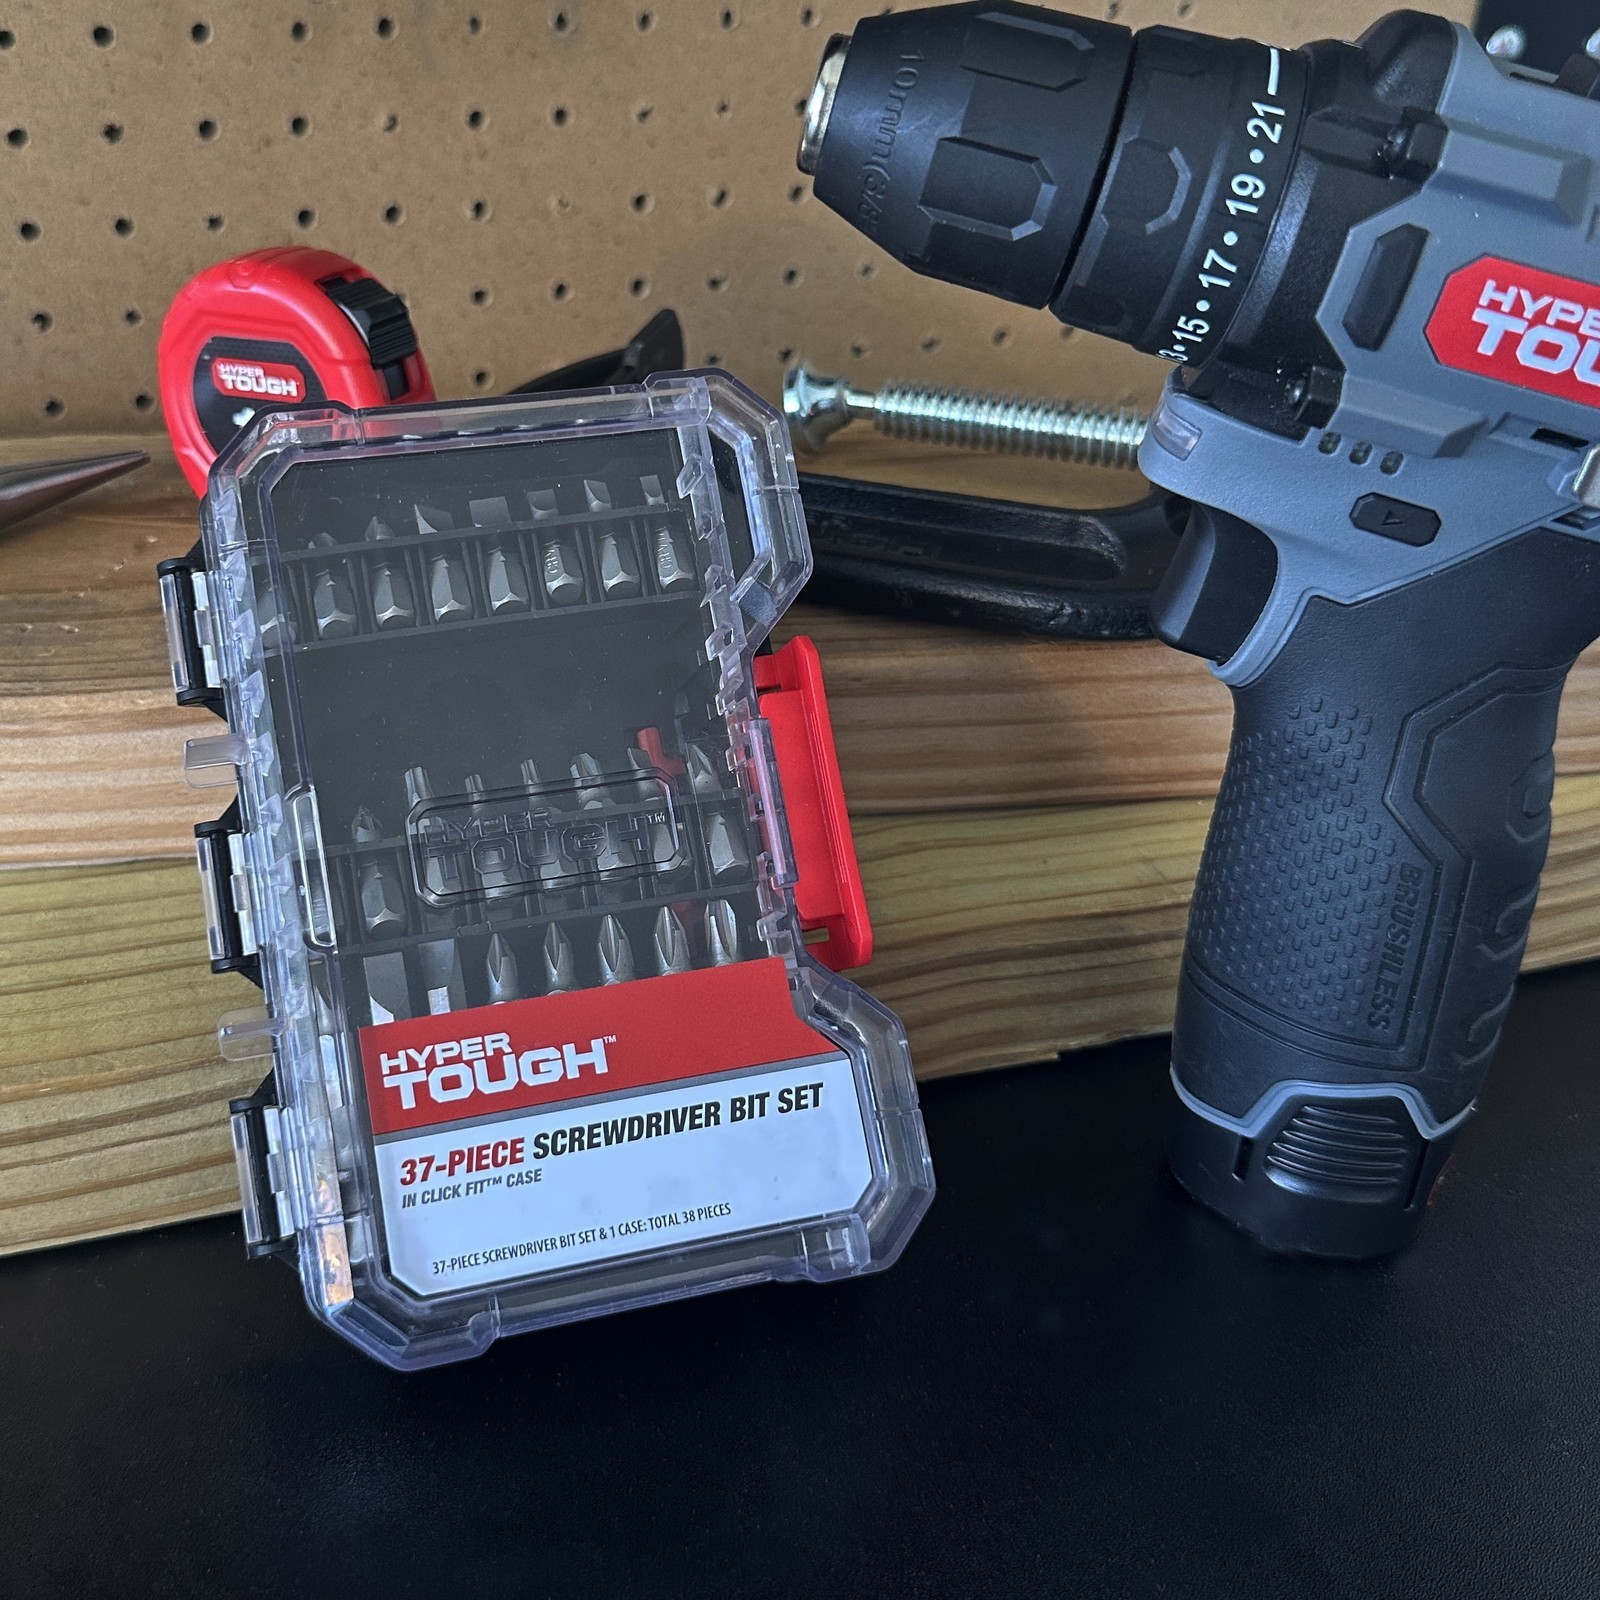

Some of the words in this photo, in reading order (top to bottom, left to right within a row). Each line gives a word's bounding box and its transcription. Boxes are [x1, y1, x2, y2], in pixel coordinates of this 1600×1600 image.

[1172, 315, 1210, 343] 15
[1198, 248, 1238, 289] 17
[1225, 173, 1267, 216] 19
[1246, 101, 1287, 144] 21
[217, 363, 265, 378] HYPER
[1367, 862, 1425, 1030] BRUSHLESS
[380, 1032, 513, 1075] HYPER
[400, 1137, 525, 1186] 37-PIECE
[533, 1101, 721, 1160] SCREWDRIVER
[730, 1091, 770, 1123] BIT
[778, 1082, 824, 1114] SET
[402, 1192, 417, 1208] IN
[421, 1184, 462, 1205] CLICK
[506, 1168, 543, 1188] CASE
[432, 1253, 481, 1275] 37-PIECE
[482, 1238, 558, 1264] SCREWDRIVER
[560, 1233, 577, 1249] BIT
[578, 1229, 597, 1245] SET
[599, 1227, 608, 1240] &
[609, 1225, 616, 1239] 1
[618, 1220, 648, 1237] CASE:
[648, 1212, 681, 1231] TOTAL
[682, 1210, 696, 1224] 38
[697, 1202, 732, 1221] PIECES
